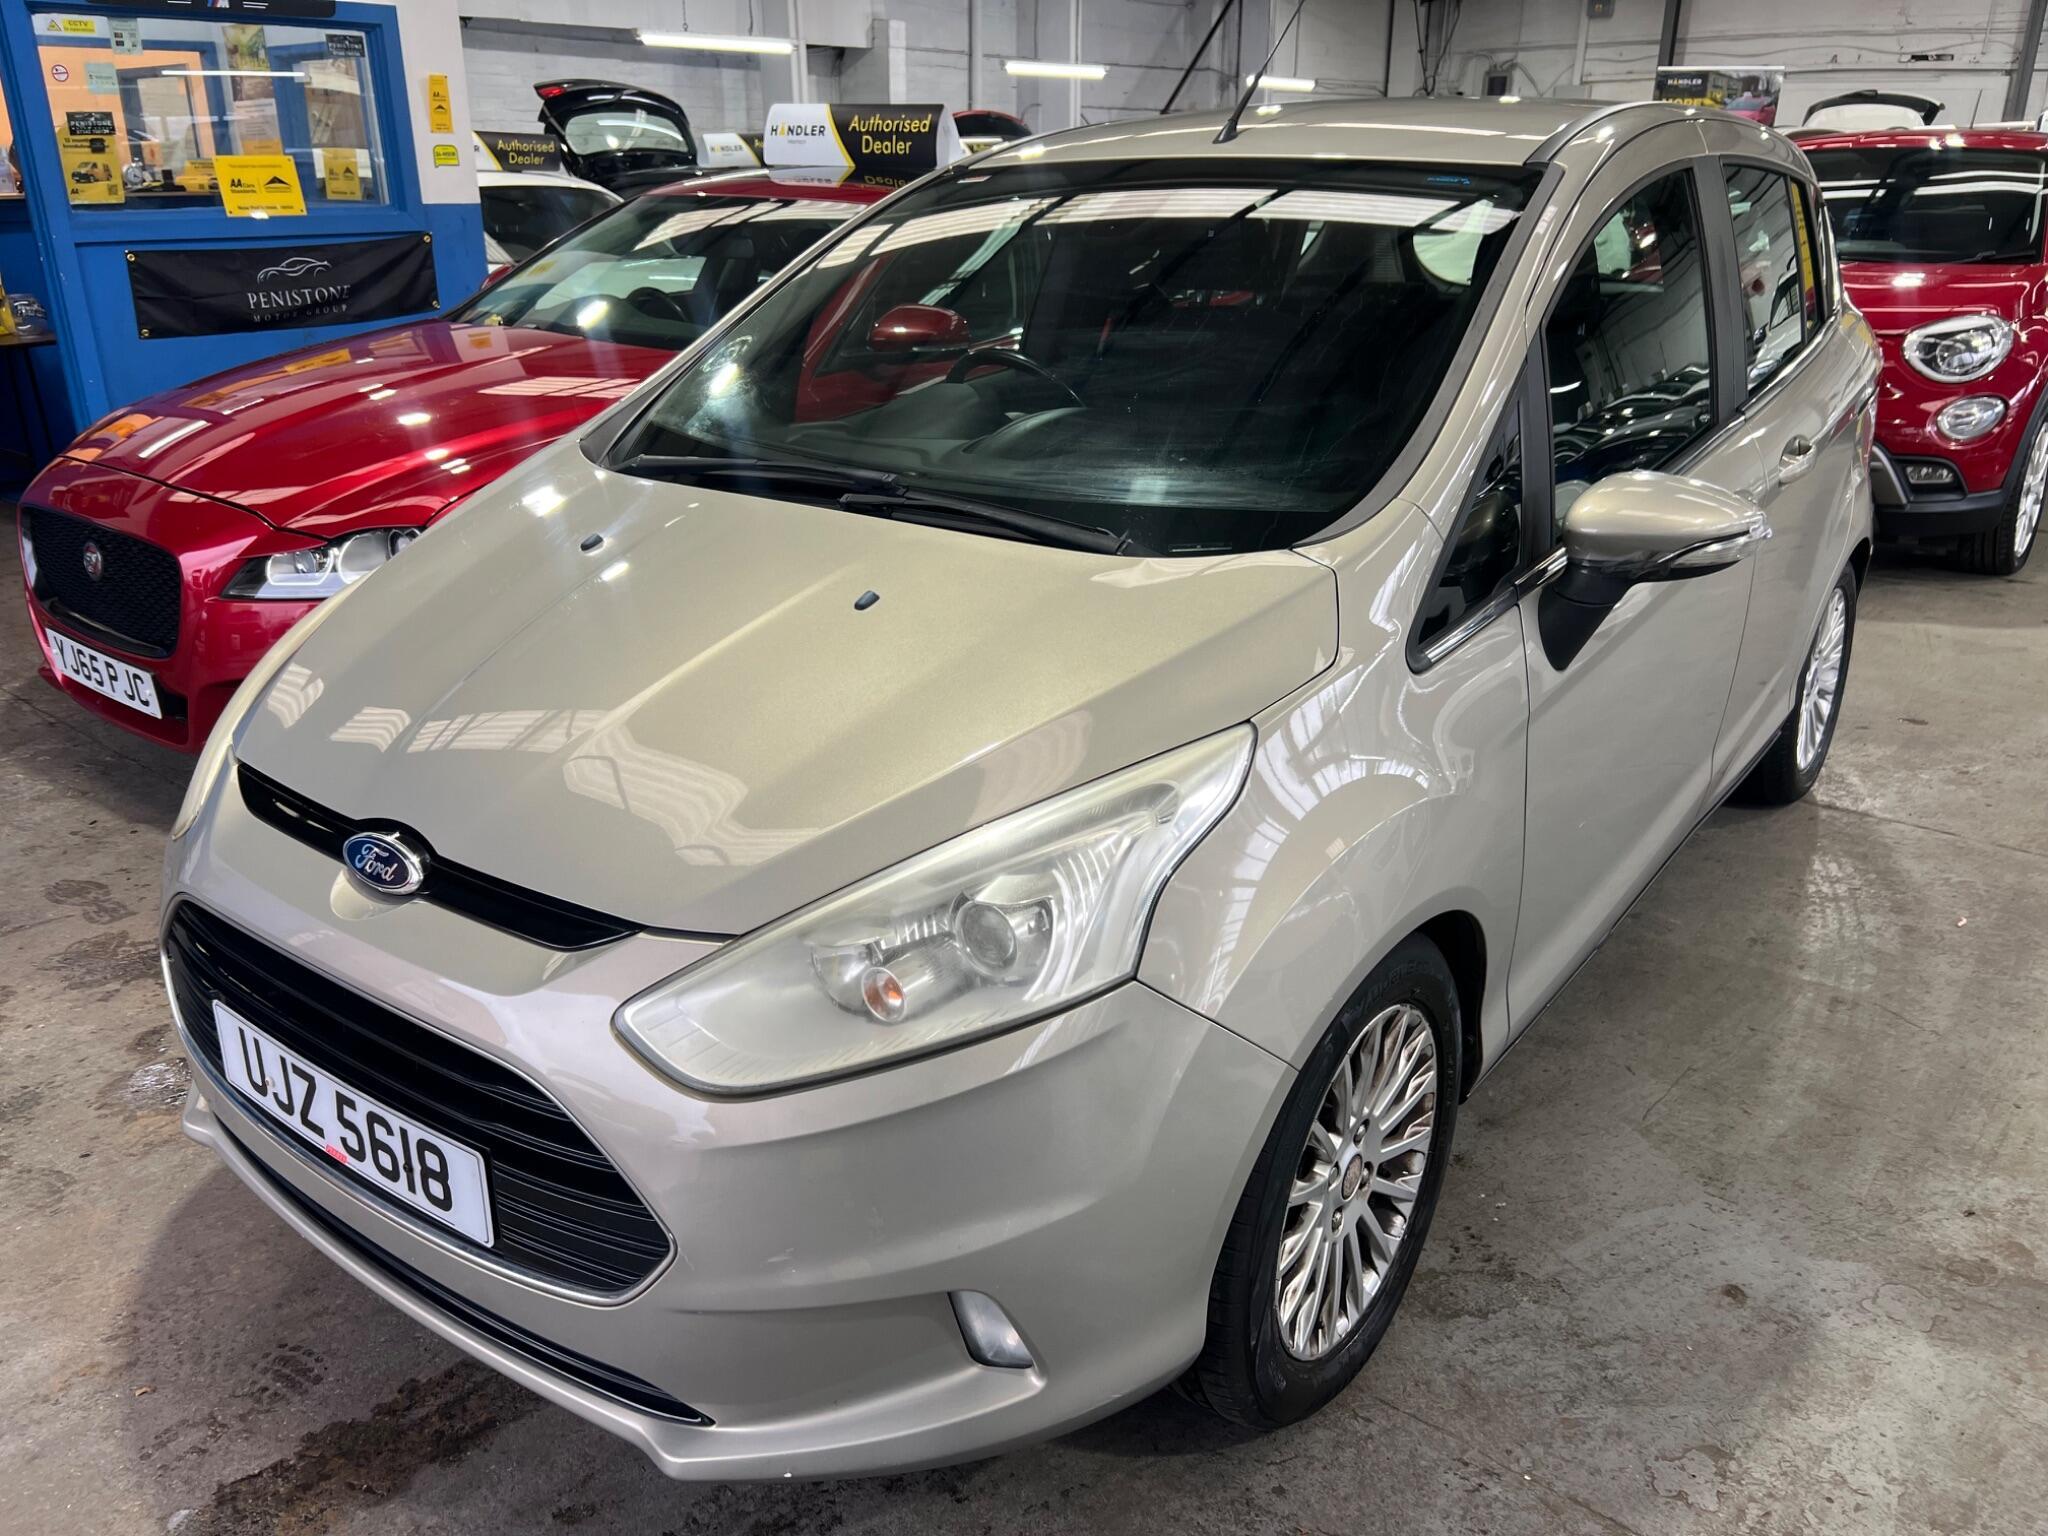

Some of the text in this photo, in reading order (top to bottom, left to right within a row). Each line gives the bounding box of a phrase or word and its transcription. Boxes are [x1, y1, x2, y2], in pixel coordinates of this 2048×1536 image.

[848, 113, 932, 132] Authorised
[497, 139, 556, 153] Authorised
[862, 134, 912, 154] Dealer
[509, 152, 544, 165] Dealer
[230, 178, 243, 188] AA
[247, 284, 351, 309] PENISTONE
[306, 304, 347, 316] GROUP
[355, 843, 399, 882] Ford
[238, 1026, 453, 1212] UJZ 5618
